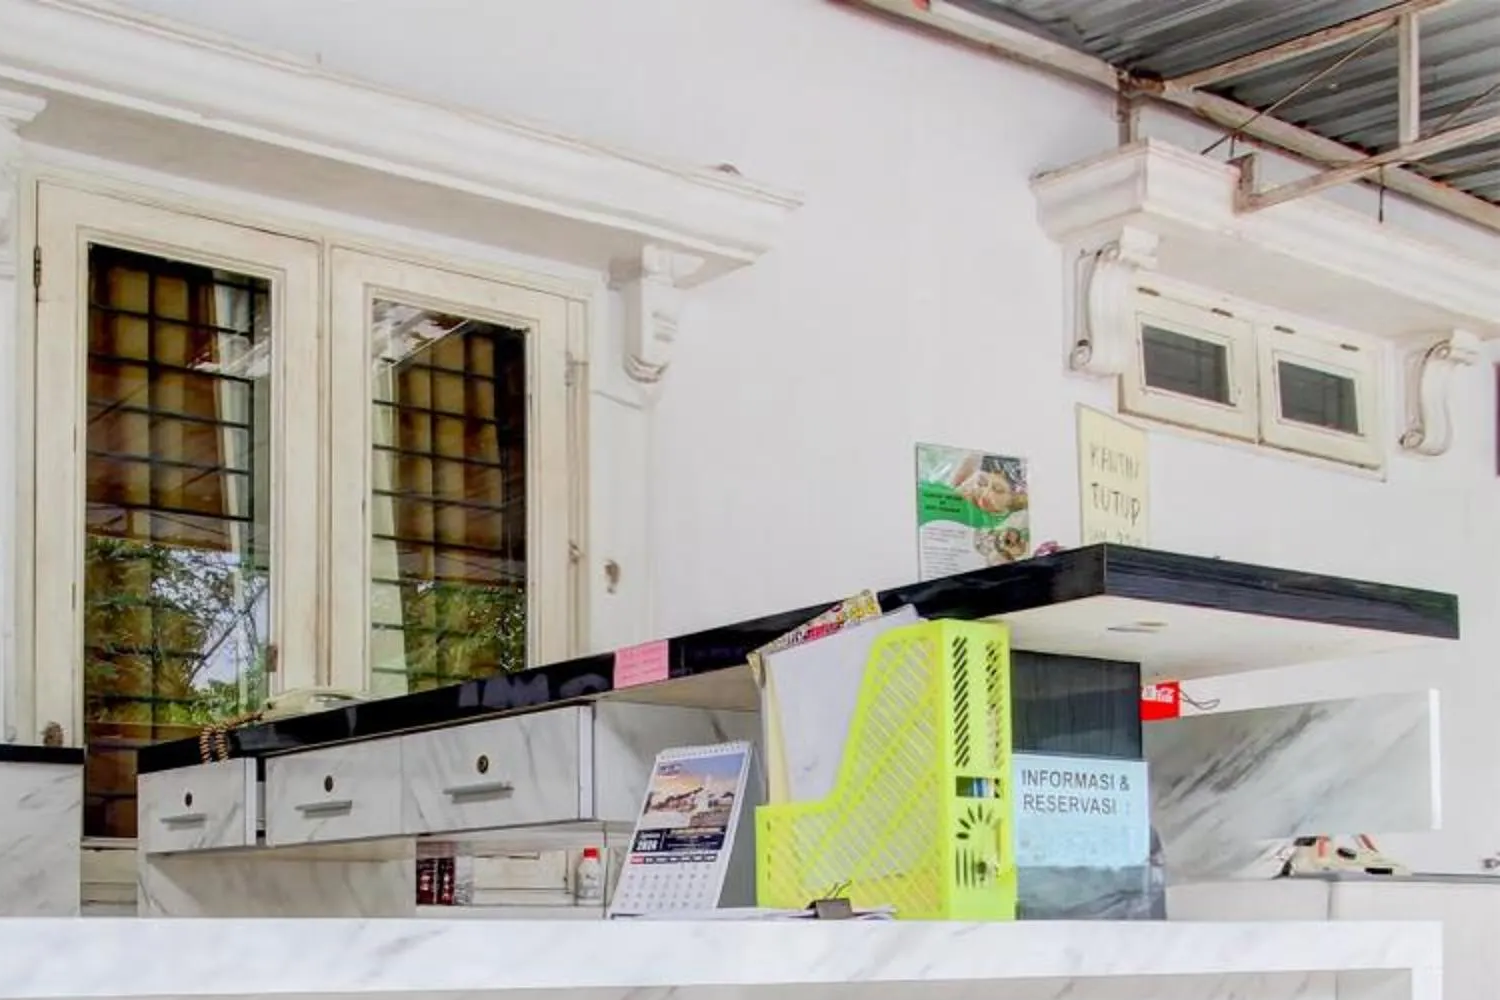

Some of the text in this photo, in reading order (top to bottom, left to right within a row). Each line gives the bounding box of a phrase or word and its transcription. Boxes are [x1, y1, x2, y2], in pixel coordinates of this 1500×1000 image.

[1091, 481, 1141, 527] TUTUP
[1020, 768, 1131, 792] INFORMASI &
[1023, 793, 1117, 815] RESERVASI
